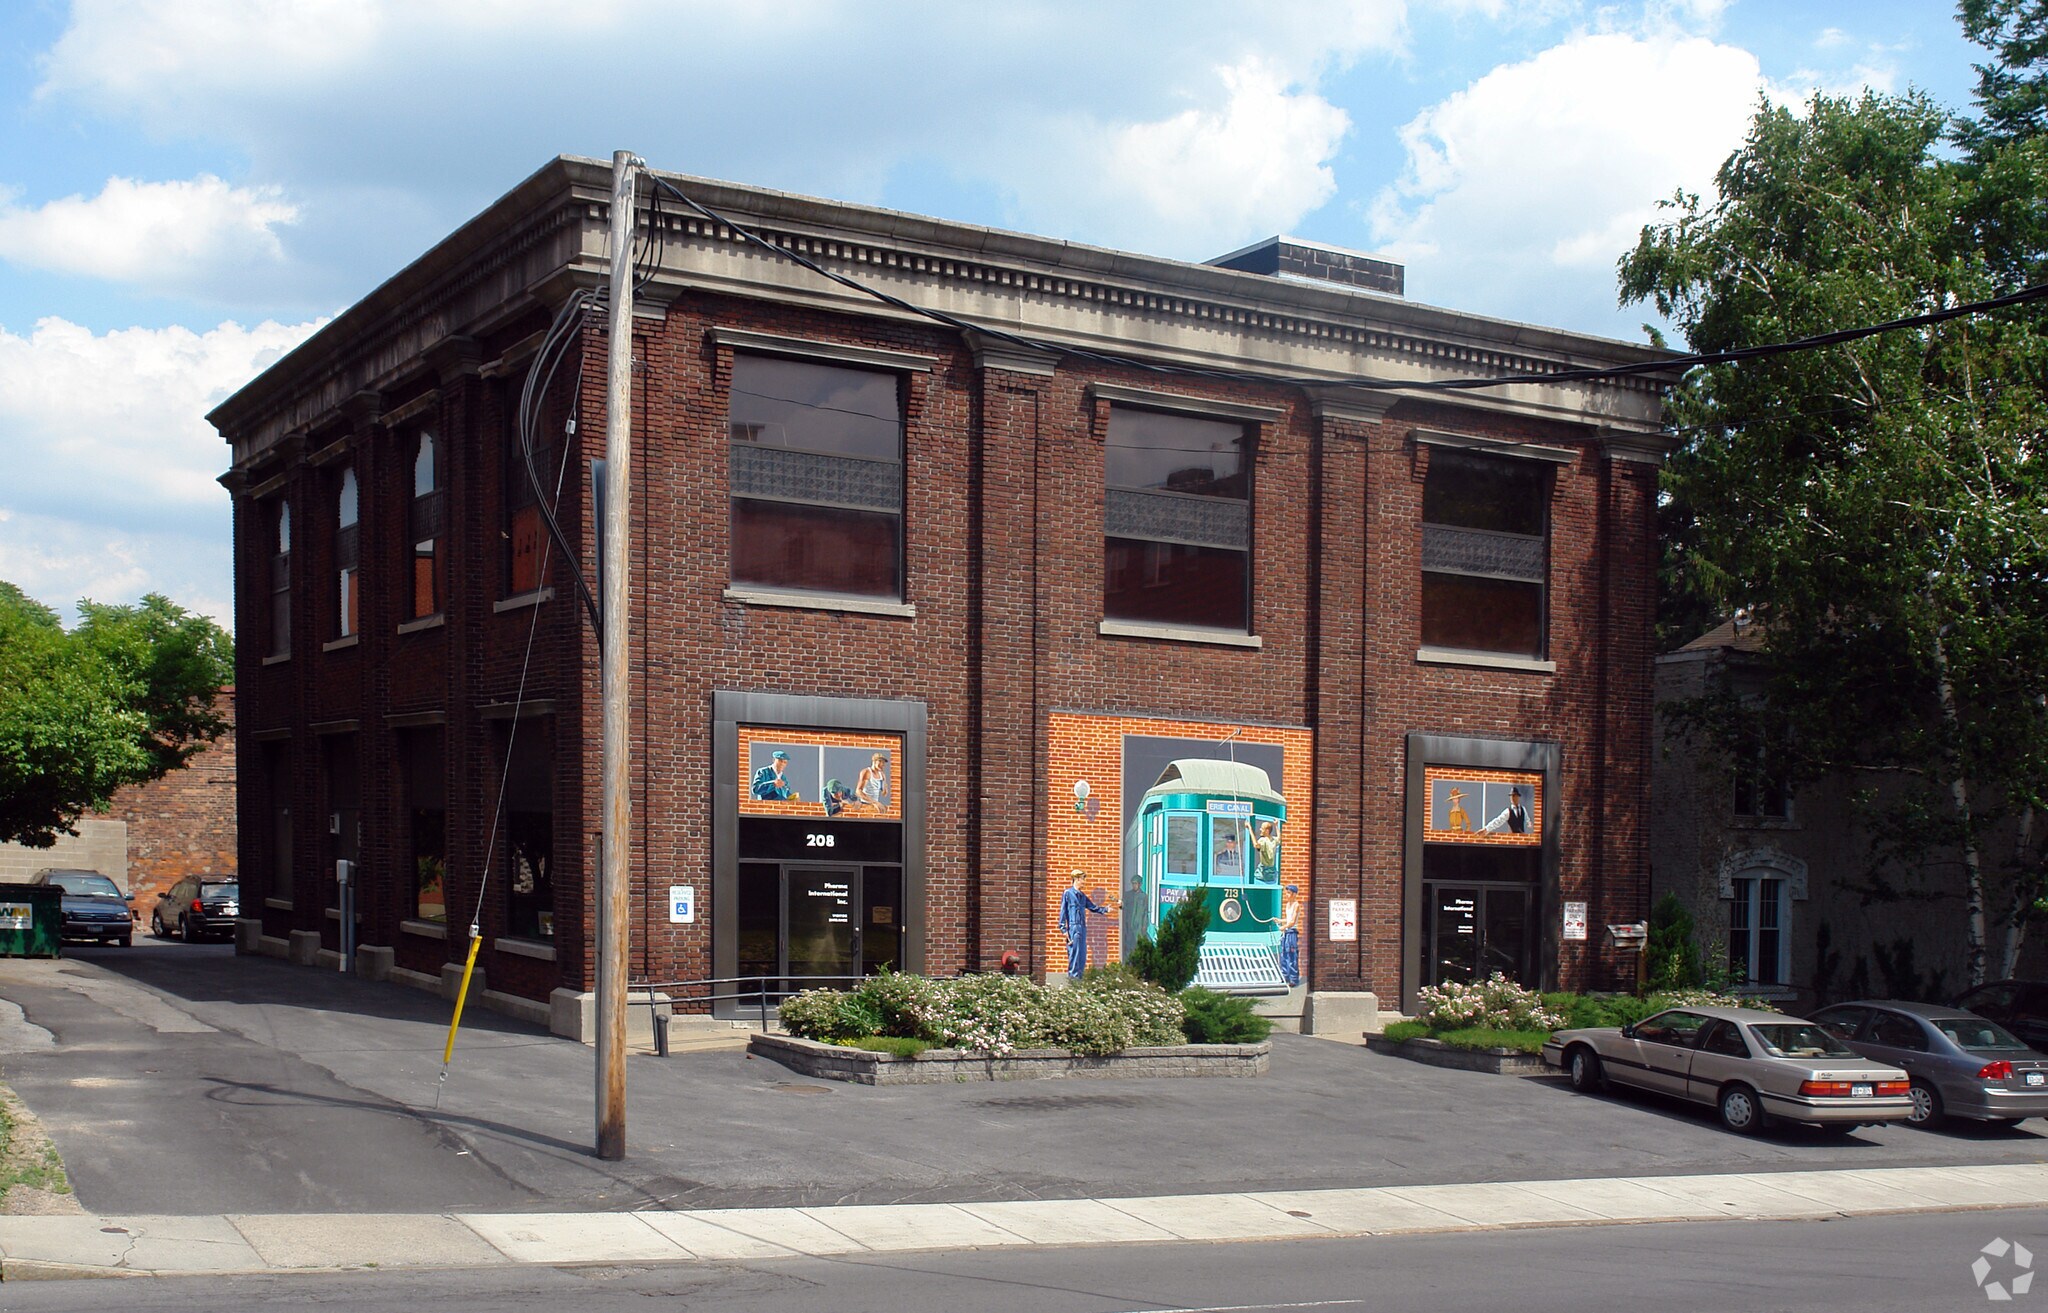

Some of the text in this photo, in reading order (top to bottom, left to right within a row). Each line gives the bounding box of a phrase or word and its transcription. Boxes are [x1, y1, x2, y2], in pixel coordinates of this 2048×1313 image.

[1210, 803, 1250, 813] ERIE CANAL
[806, 834, 835, 847] 208
[1166, 888, 1180, 896] PAY
[1224, 888, 1239, 898] 713
[1161, 895, 1175, 903] YOU
